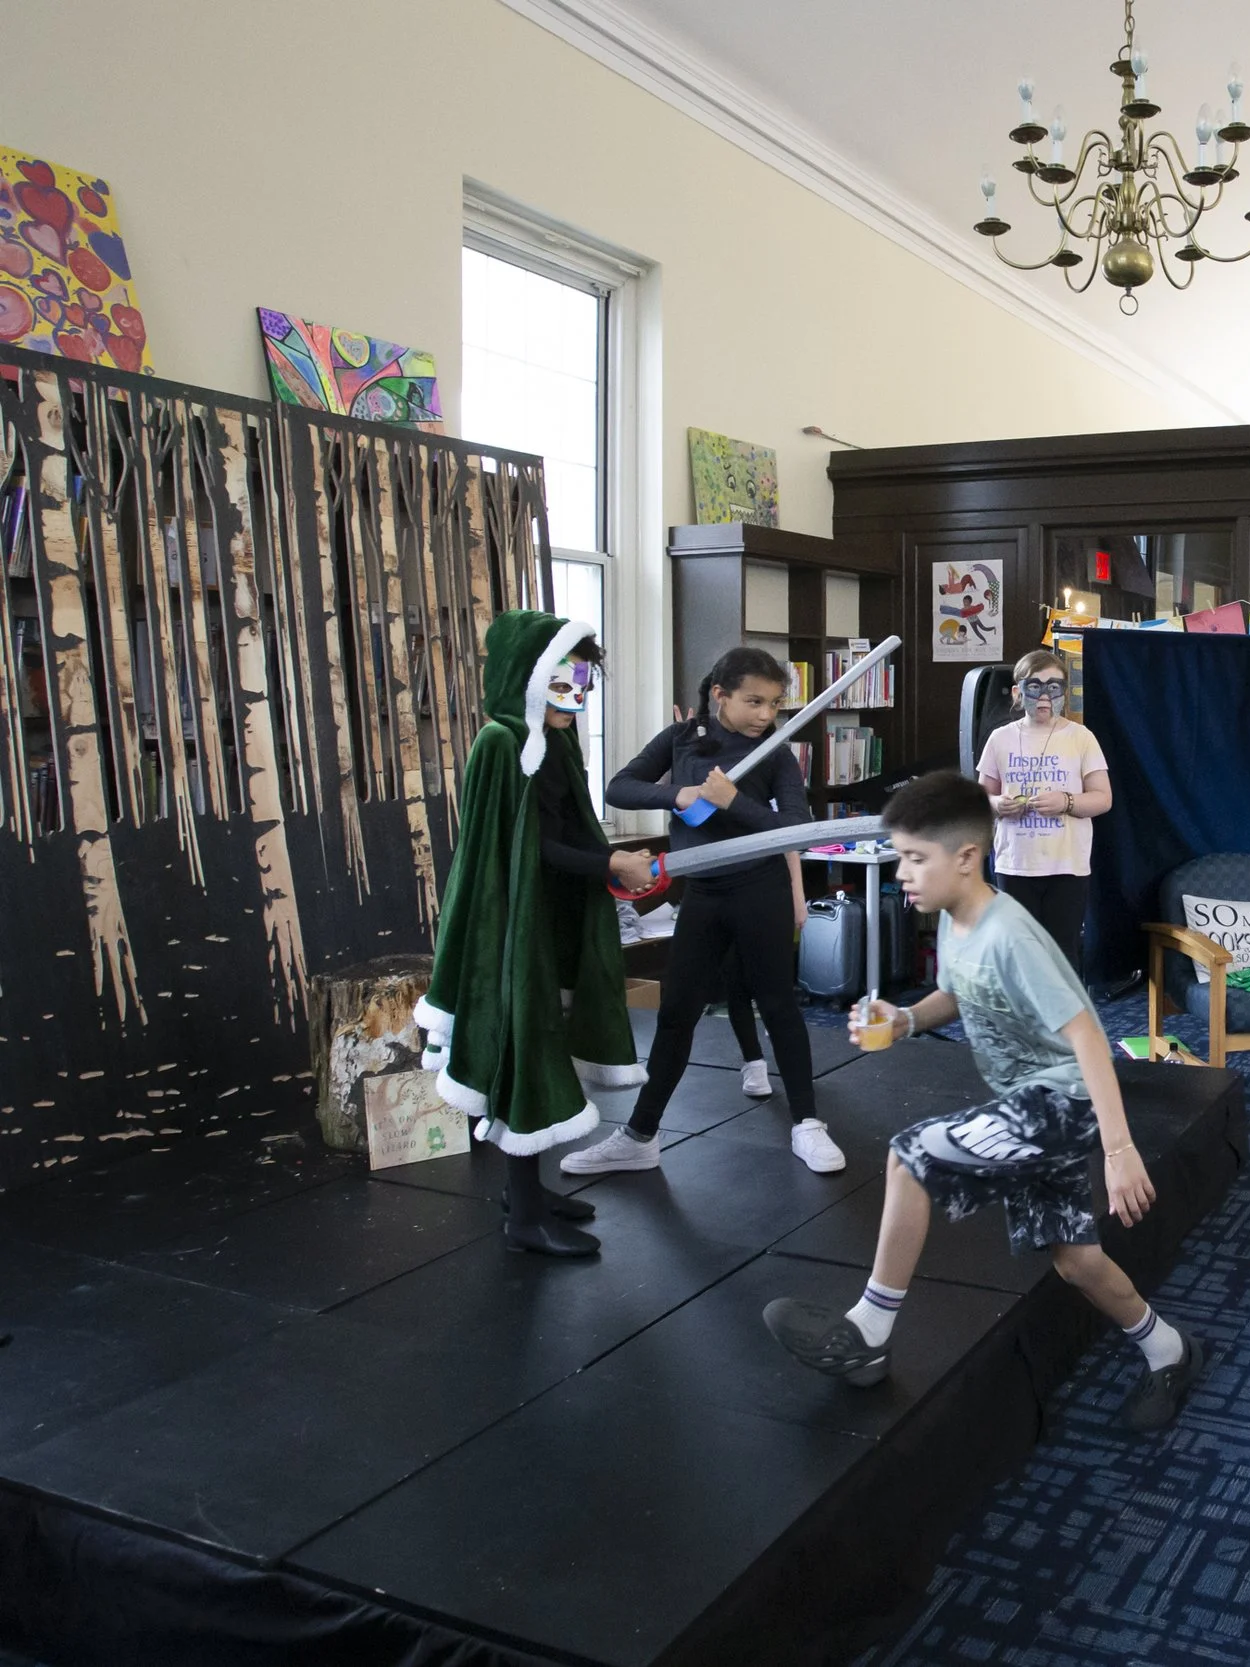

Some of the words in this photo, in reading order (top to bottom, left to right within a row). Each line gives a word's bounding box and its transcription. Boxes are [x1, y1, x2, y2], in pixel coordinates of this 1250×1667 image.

[1009, 752, 1059, 771] Inspire
[1005, 767, 1069, 784] creativity
[1021, 783, 1041, 796] for
[1194, 904, 1238, 927] SO
